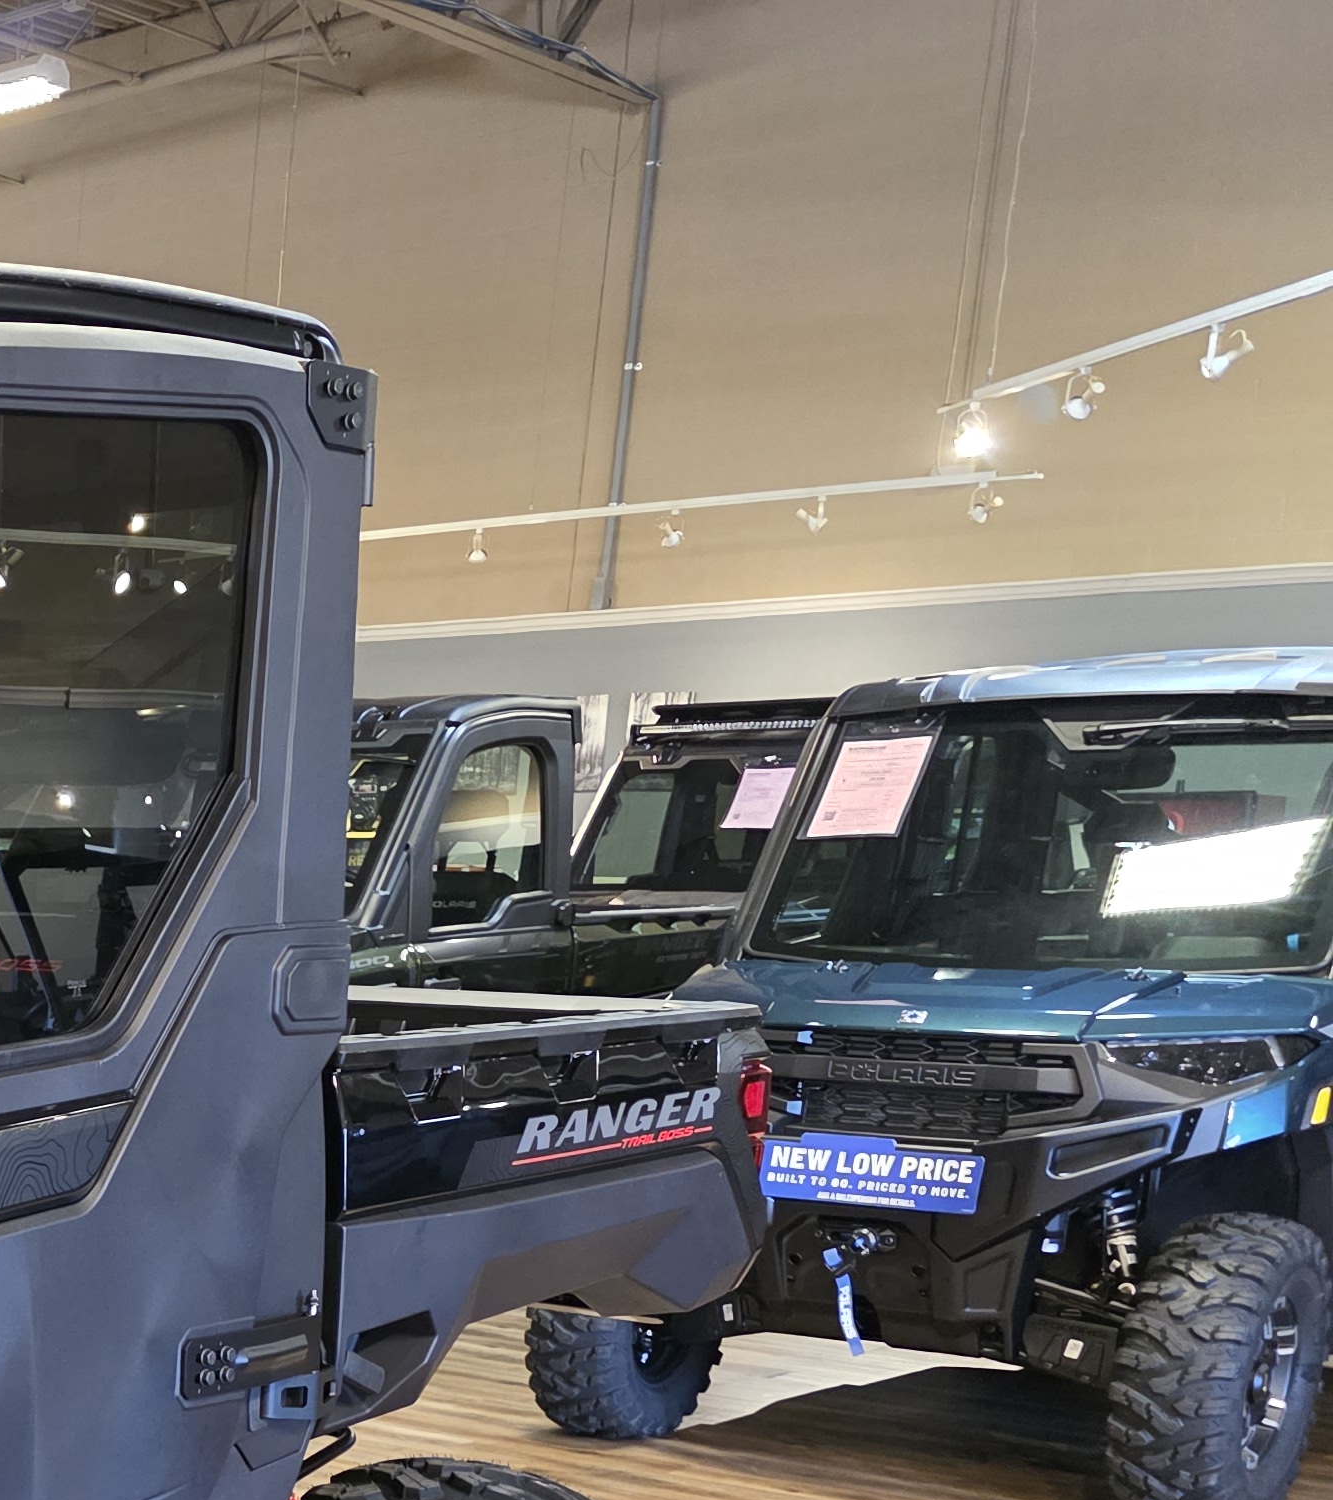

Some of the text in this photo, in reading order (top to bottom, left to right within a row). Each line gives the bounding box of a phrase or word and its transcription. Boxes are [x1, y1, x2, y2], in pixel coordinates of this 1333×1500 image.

[432, 900, 477, 909] OLARIS
[828, 1060, 976, 1087] POLARIS
[517, 1086, 721, 1154] RANGER
[621, 1126, 694, 1149] TRAIL BOSS
[770, 1145, 976, 1184] NEW LOW PRICE
[767, 1171, 806, 1184] BUILT
[810, 1175, 826, 1187] TO
[857, 1180, 906, 1194] PRICED
[910, 1184, 926, 1196] TO
[930, 1186, 970, 1199] MOVE.
